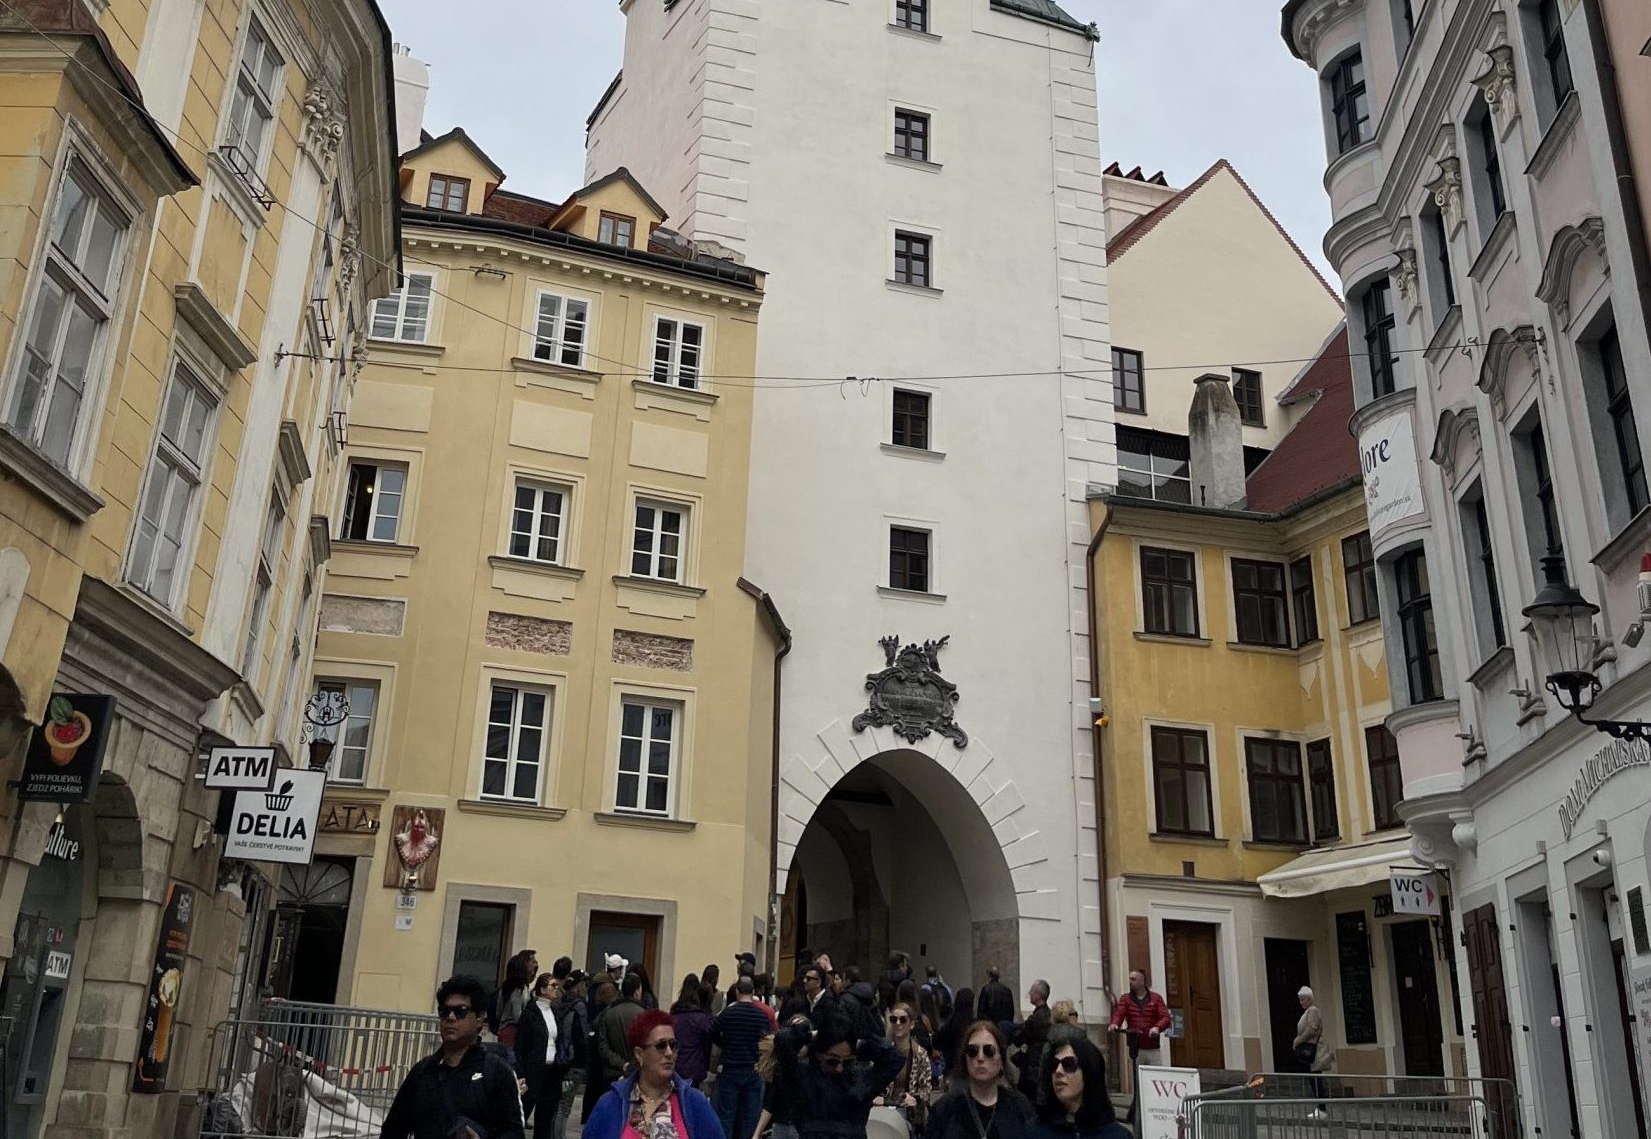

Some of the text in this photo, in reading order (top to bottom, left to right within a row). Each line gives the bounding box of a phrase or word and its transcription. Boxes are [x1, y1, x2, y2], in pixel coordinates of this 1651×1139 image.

[213, 756, 269, 778] ATM
[236, 812, 307, 840] DELIA
[1394, 878, 1423, 893] WC
[48, 955, 69, 974] ATM
[1152, 1080, 1187, 1099] WC
